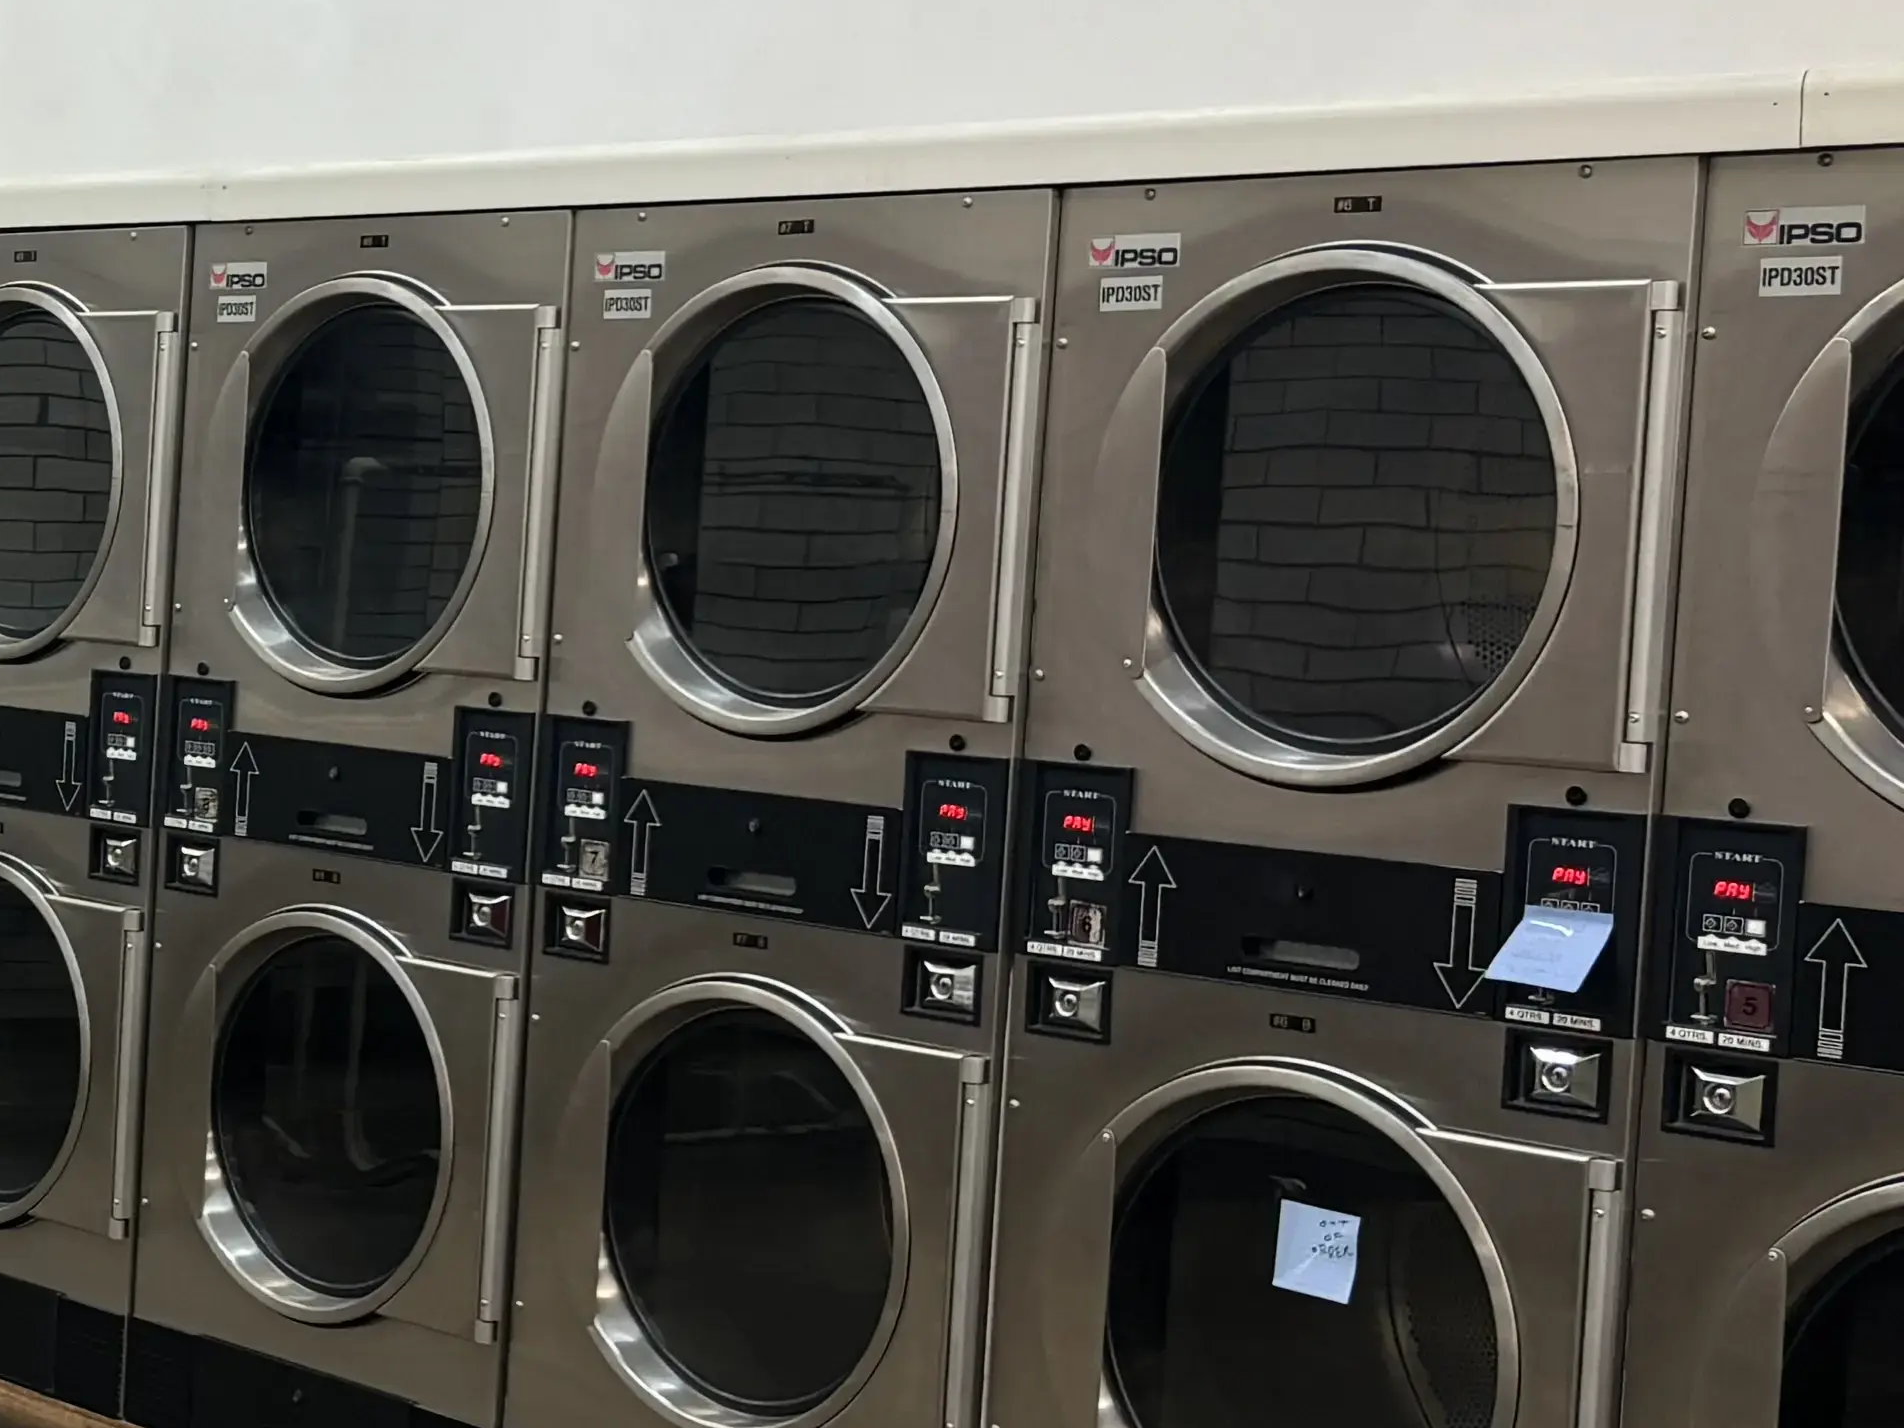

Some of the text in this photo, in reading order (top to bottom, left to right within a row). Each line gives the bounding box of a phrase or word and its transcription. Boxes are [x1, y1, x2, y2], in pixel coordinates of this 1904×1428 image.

[1779, 222, 1862, 245] IPSO
[1114, 247, 1178, 267] IPSO
[225, 273, 266, 288] IPSO
[614, 264, 662, 280] IPSO
[1762, 266, 1840, 287] IPD30ST
[1551, 837, 1596, 849] START
[588, 851, 599, 866] 7
[1714, 851, 1763, 863] START
[1714, 881, 1751, 899] PAY
[1743, 997, 1757, 1016] 5
